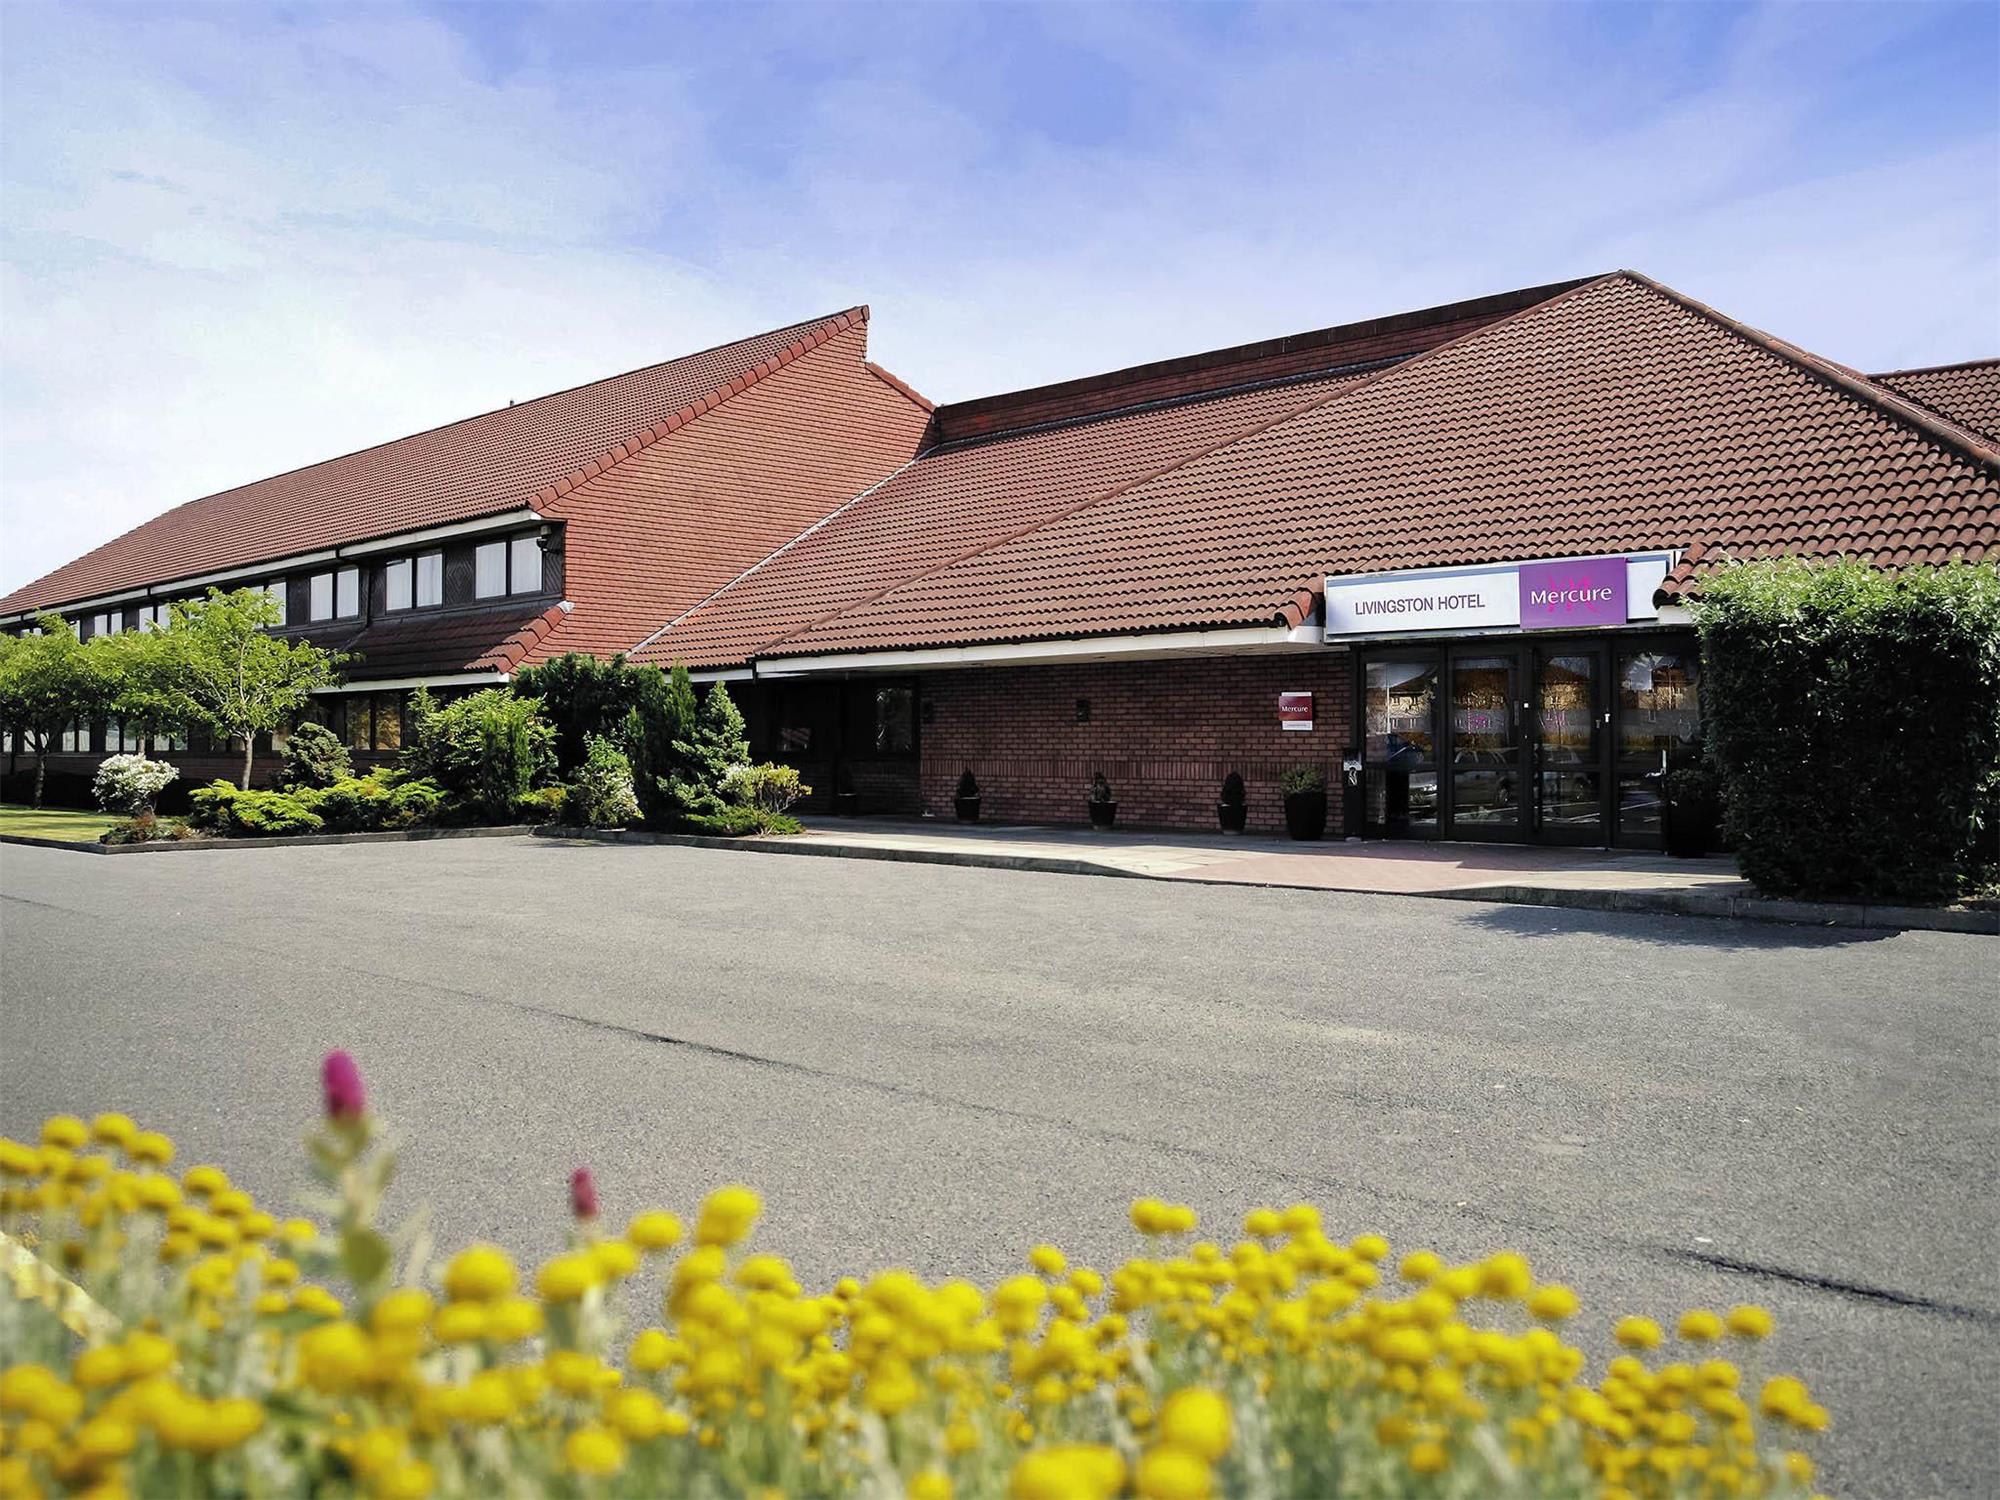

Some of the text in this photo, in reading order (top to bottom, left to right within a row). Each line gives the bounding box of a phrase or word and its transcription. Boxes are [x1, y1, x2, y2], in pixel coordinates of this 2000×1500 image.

[1355, 594, 1485, 615] LIVINGSTON HOTEL
[1530, 587, 1612, 605] Mercure
[1281, 705, 1309, 713] Mercure
